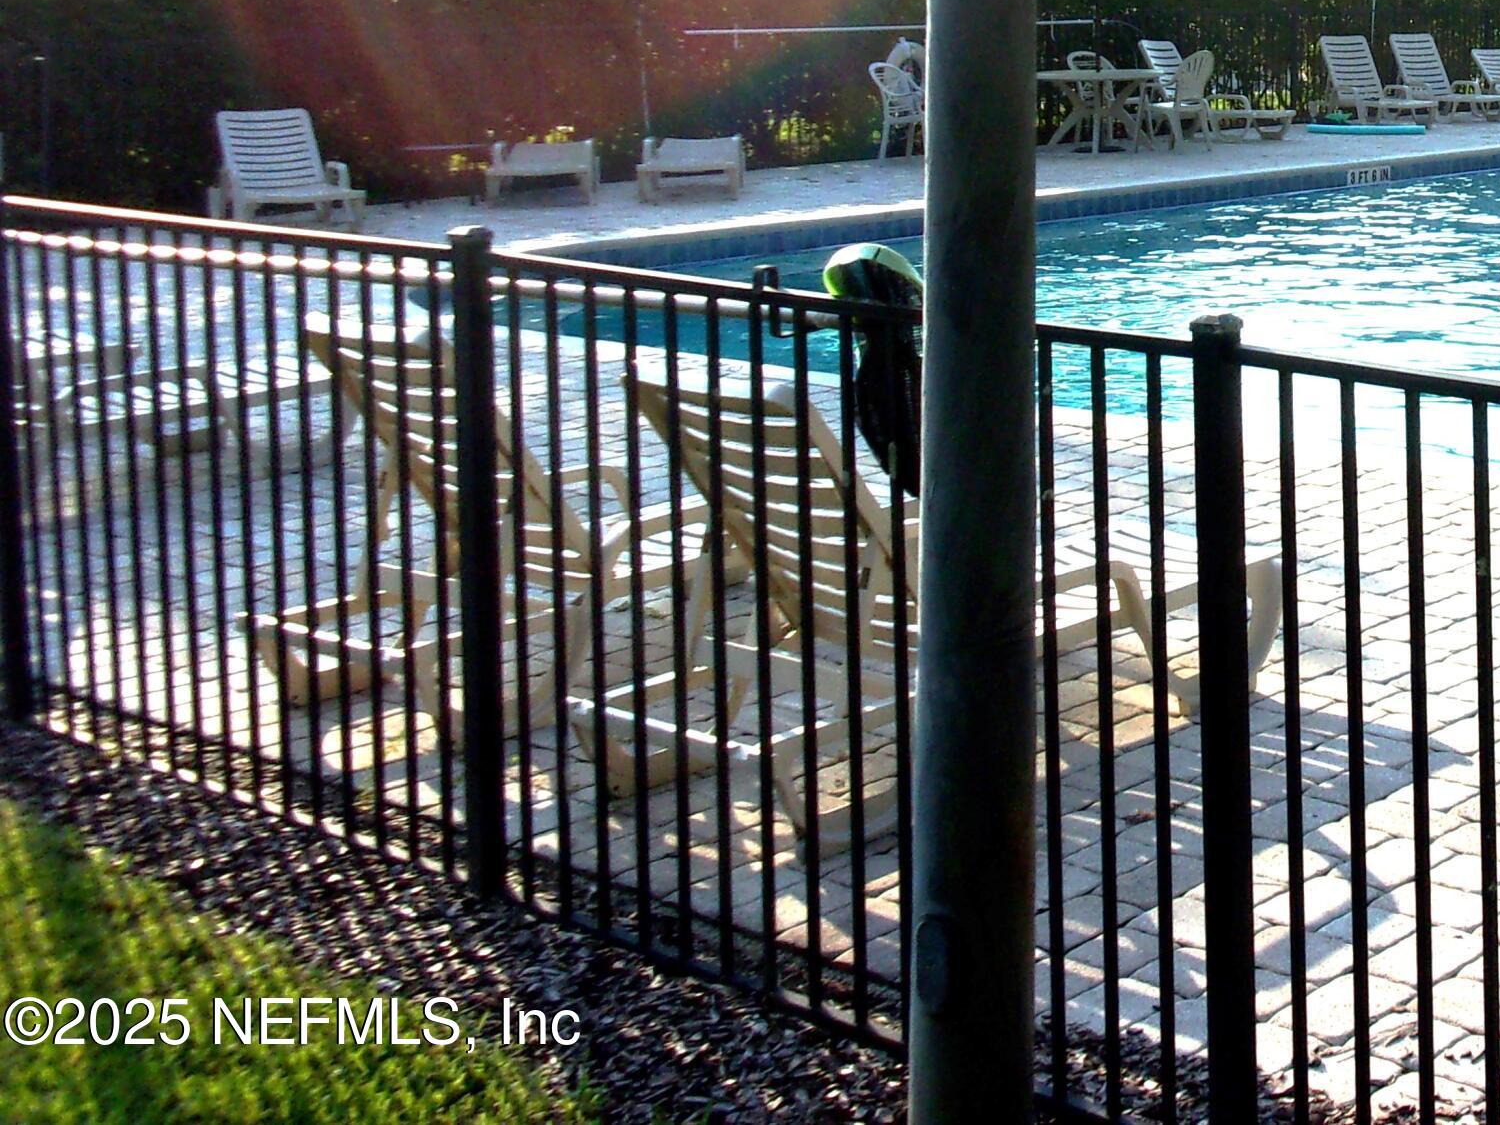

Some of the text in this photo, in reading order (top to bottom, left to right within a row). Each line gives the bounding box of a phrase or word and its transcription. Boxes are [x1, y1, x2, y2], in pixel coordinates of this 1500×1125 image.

[1350, 171, 1356, 185] 3
[1358, 170, 1369, 184] FT
[1380, 167, 1389, 182] IN
